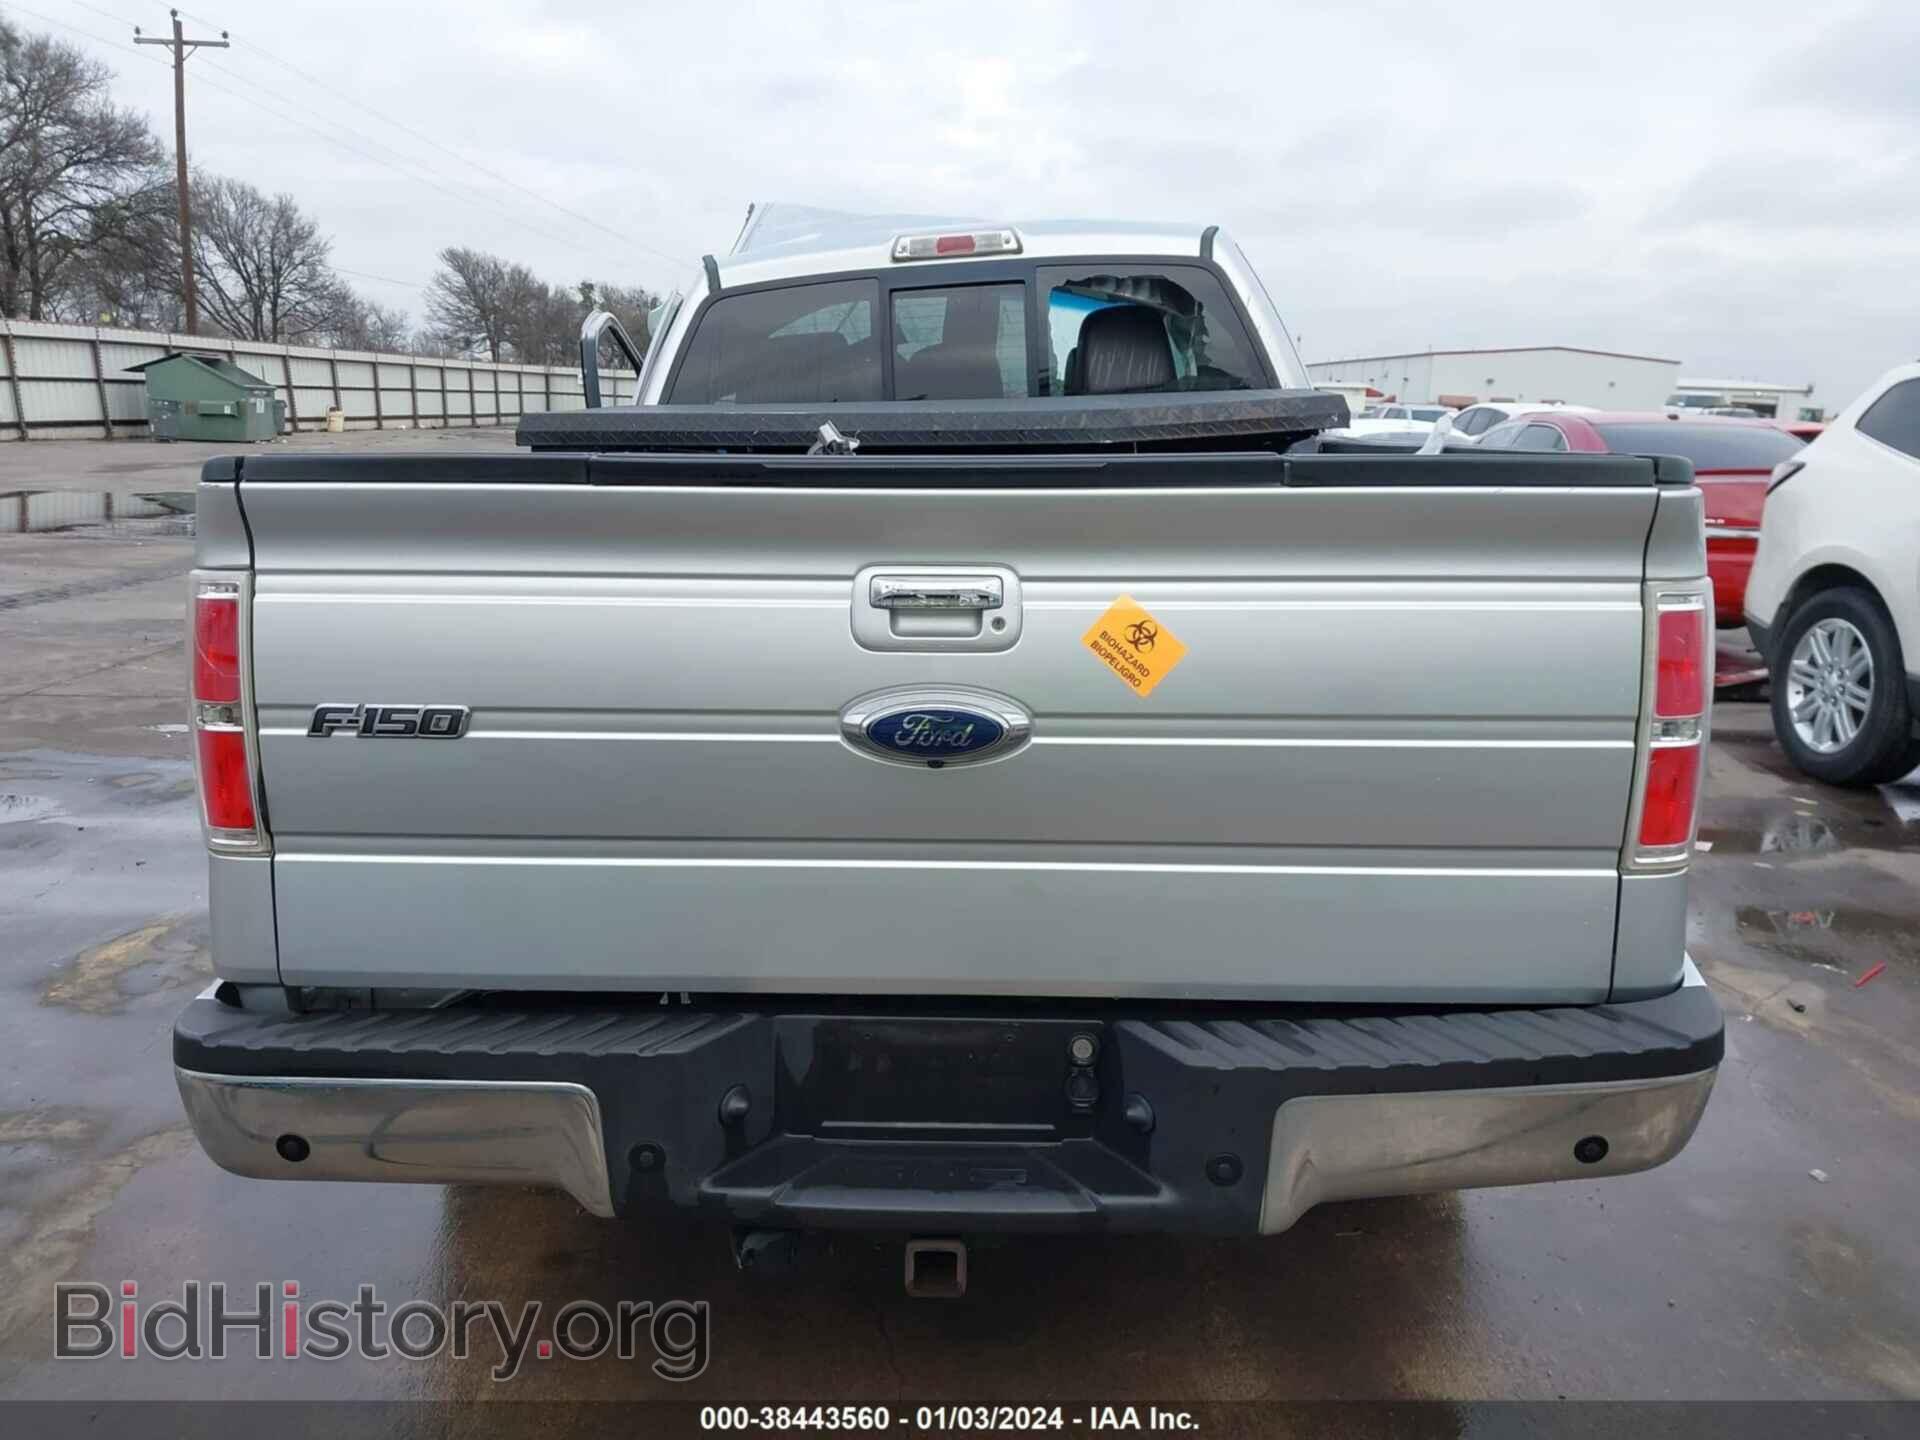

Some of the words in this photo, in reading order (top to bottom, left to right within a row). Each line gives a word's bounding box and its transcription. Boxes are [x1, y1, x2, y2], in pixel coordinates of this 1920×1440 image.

[1089, 640, 1142, 688] BIOPELIGRO
[1099, 630, 1150, 678] BIOHAZARD
[307, 703, 472, 739] F-150
[894, 713, 975, 747] Ford
